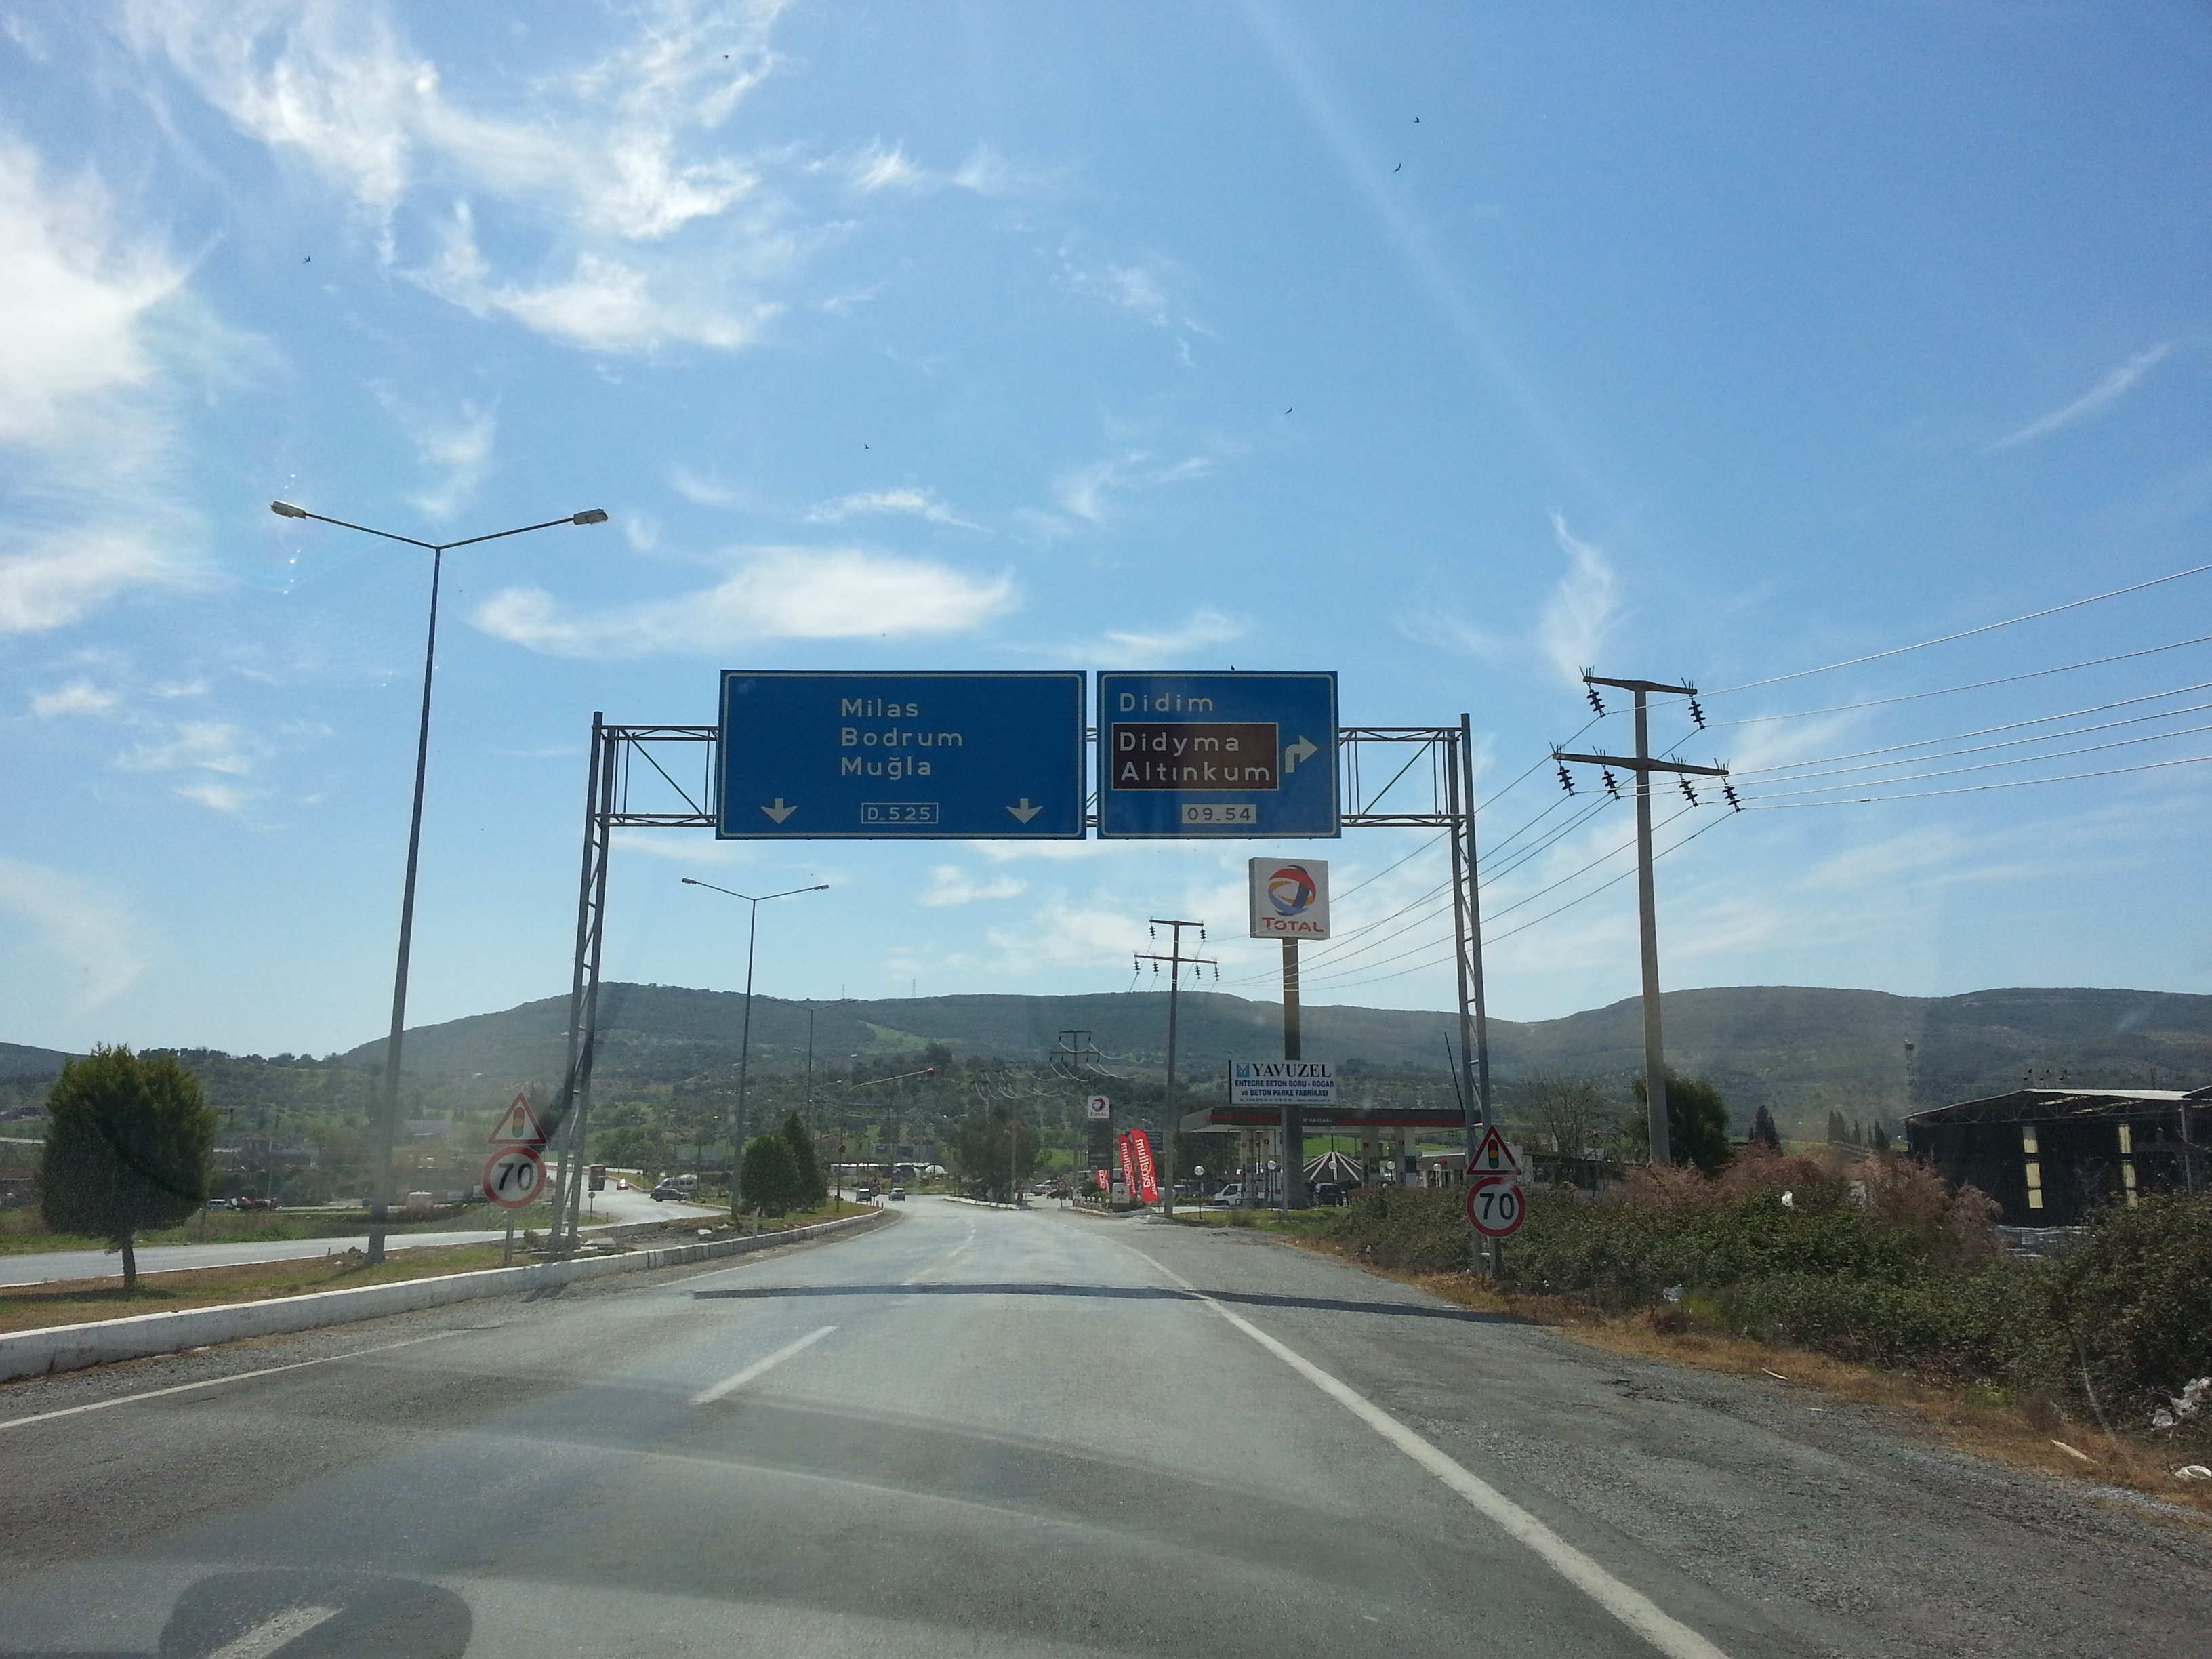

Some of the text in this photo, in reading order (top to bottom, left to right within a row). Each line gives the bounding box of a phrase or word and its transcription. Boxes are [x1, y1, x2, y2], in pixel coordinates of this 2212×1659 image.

[841, 698, 919, 718] Milas
[1119, 692, 1214, 712] Didim
[841, 726, 963, 747] Bodrum
[1119, 731, 1240, 757] Didyma
[841, 756, 933, 781] Muğla
[1120, 761, 1271, 781] Altınkum
[1261, 917, 1324, 933] TOTAL
[1252, 1063, 1332, 1078] YAVUZEL
[497, 1162, 535, 1191] 70
[1479, 1192, 1515, 1221] 70
